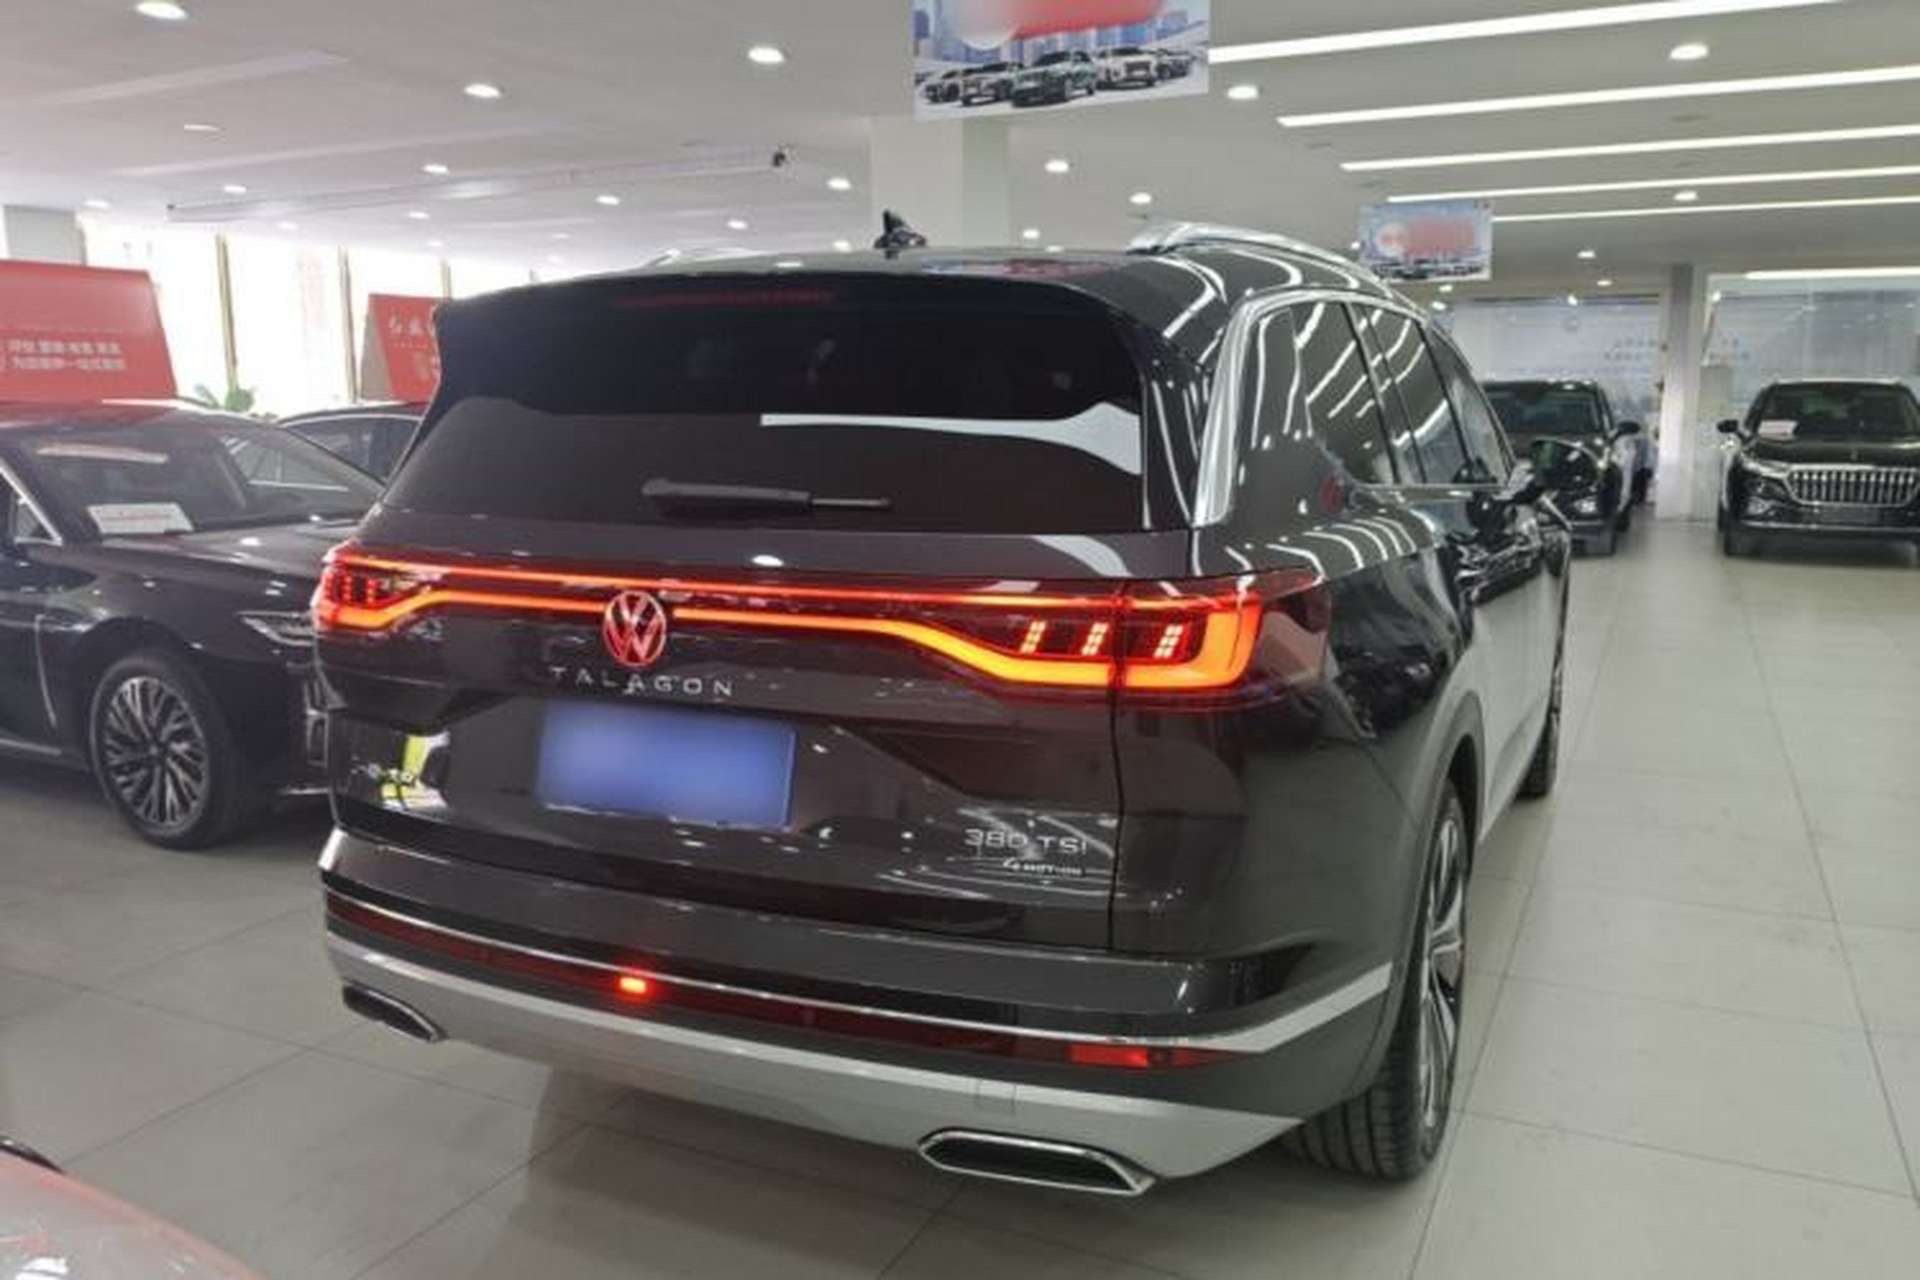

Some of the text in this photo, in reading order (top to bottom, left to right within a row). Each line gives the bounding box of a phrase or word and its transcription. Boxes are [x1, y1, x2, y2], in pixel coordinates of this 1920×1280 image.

[548, 666, 734, 698] TALAGON
[964, 828, 1088, 856] 380 TSI
